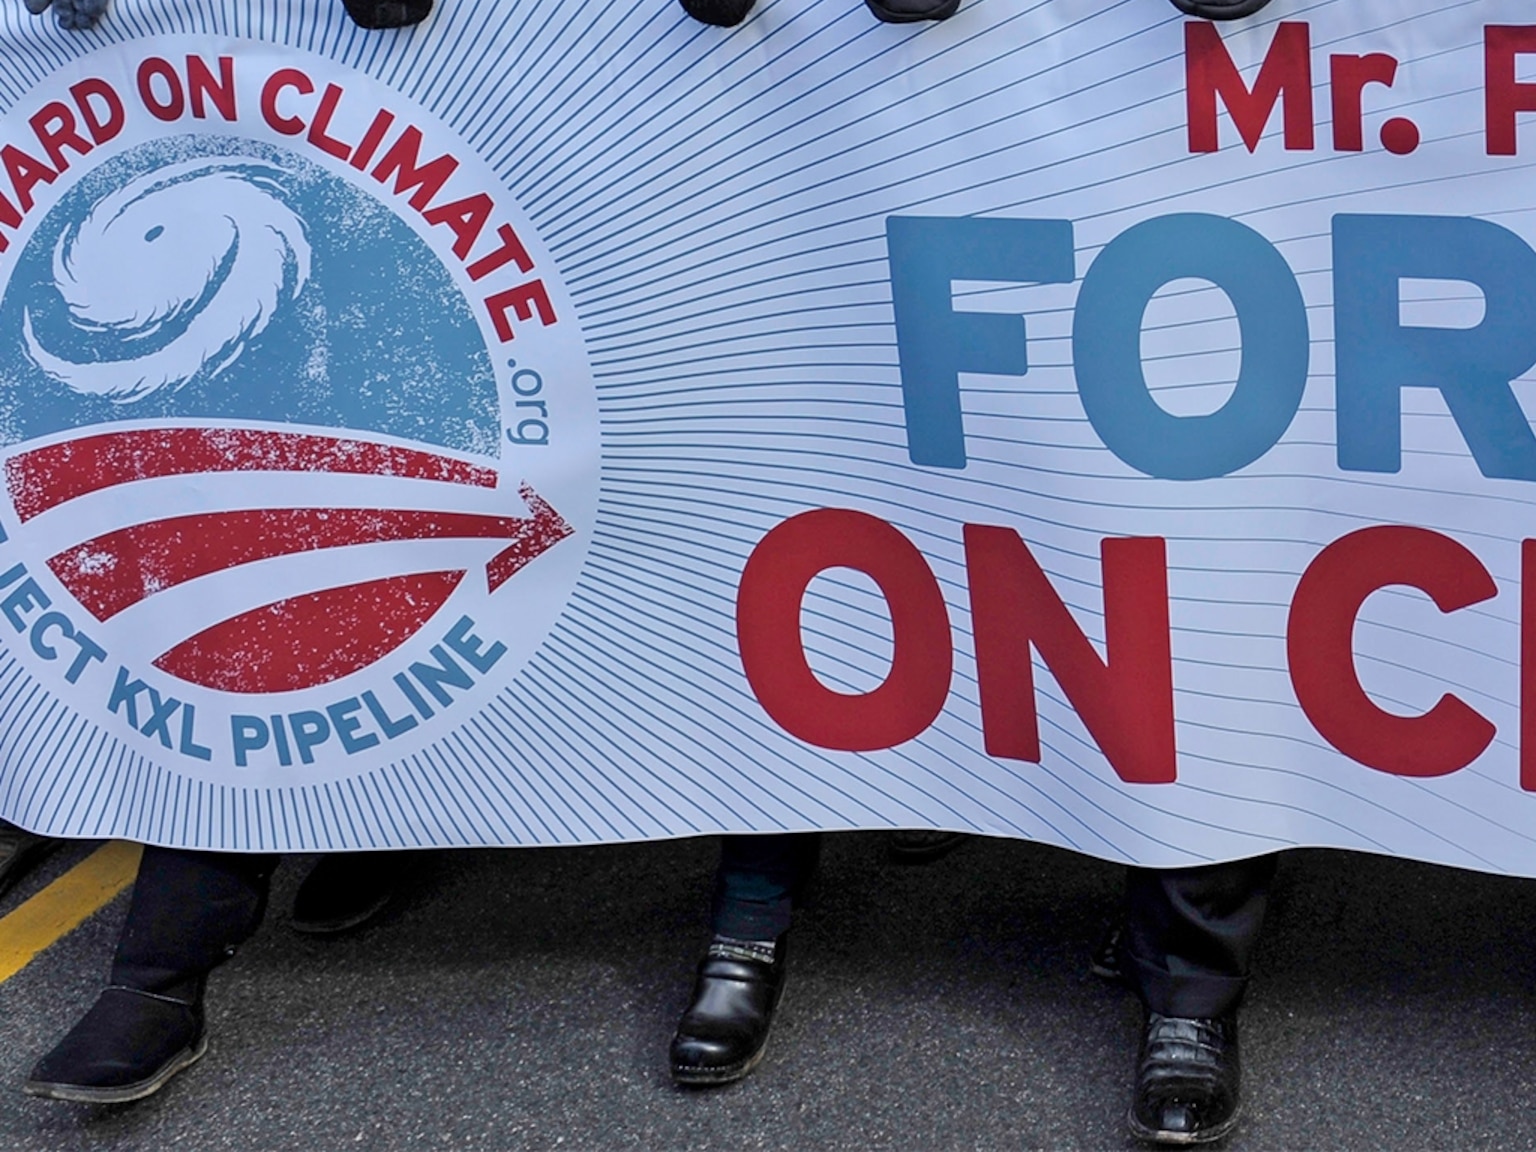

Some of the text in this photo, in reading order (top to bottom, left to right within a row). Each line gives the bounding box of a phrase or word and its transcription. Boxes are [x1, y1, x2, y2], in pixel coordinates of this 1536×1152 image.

[1183, 20, 1422, 155] Mr.
[136, 54, 239, 122] ON
[260, 67, 558, 343] CLIMATE
[507, 357, 550, 448] .org
[107, 664, 212, 762] KXL
[230, 615, 507, 768] PIPELINE
[735, 507, 1178, 785] ON
